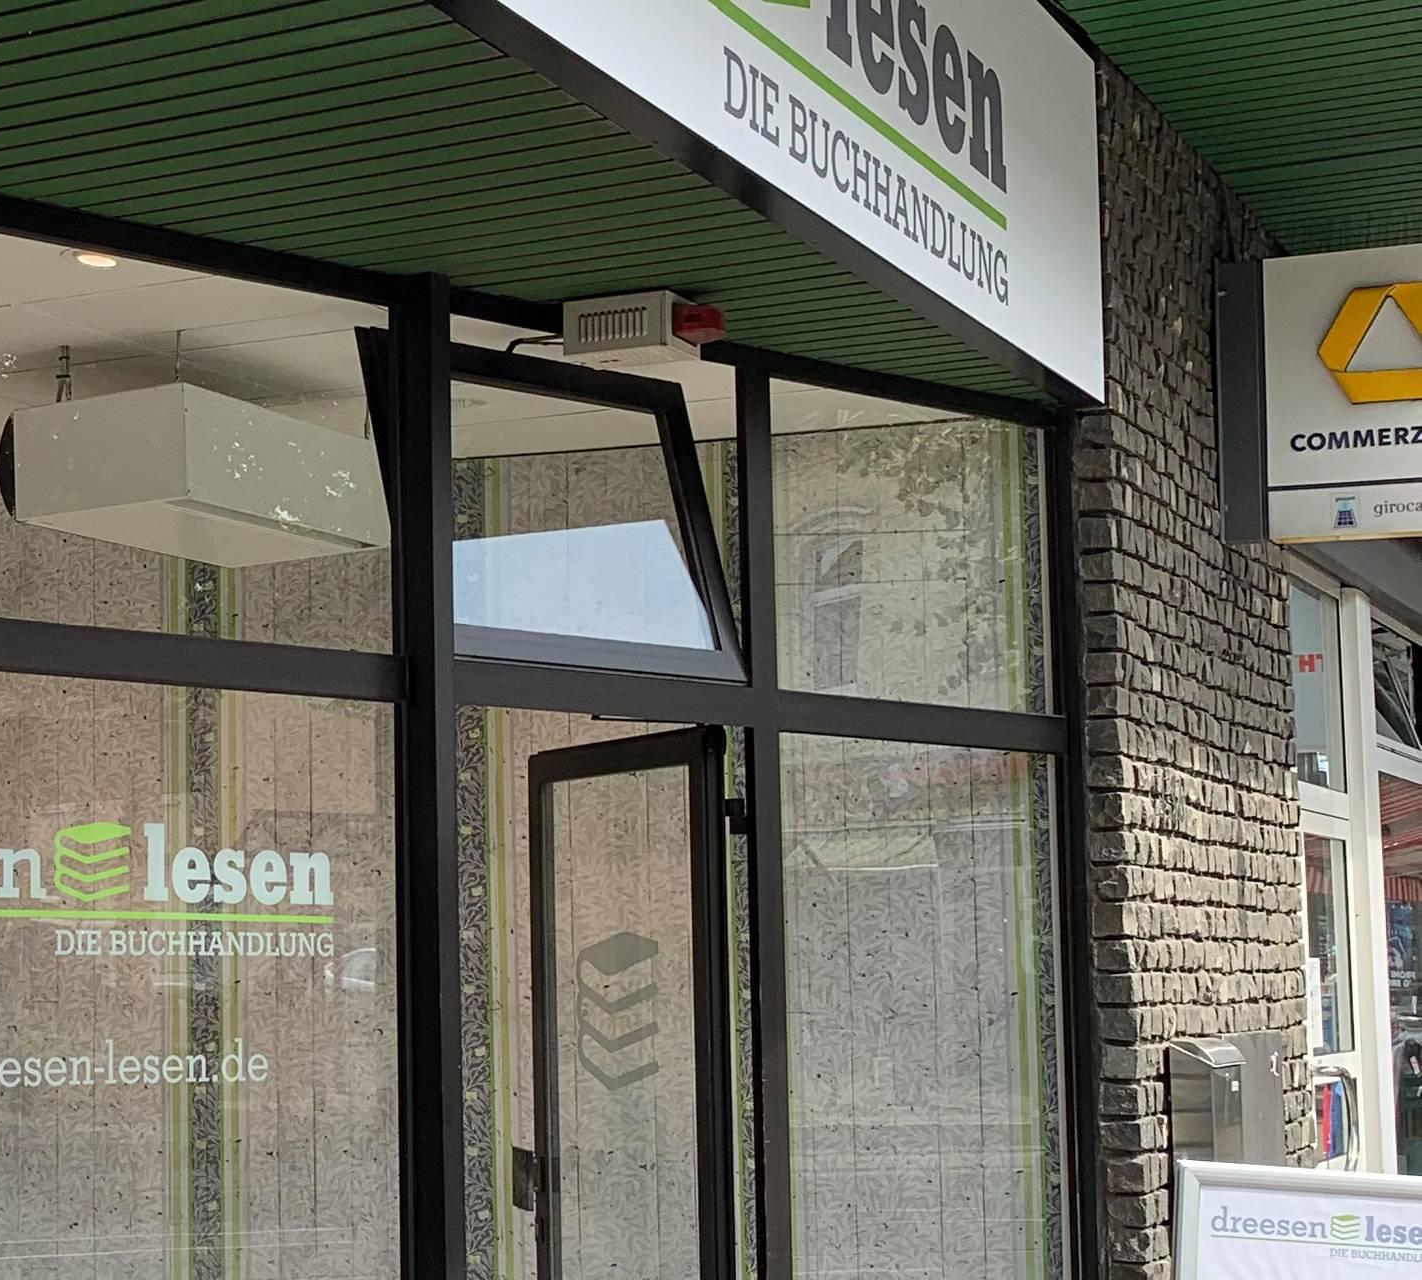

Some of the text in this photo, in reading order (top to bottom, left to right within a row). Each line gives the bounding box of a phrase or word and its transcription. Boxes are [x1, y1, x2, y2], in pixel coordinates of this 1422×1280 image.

[723, 45, 1009, 306] DIE BUCHHANDLUNG
[1289, 426, 1422, 452] COMMERZ
[144, 823, 335, 905] lesen
[55, 929, 336, 959] DIE BUCHHANDLUNG
[1211, 1206, 1328, 1239] dreesen
[1329, 1248, 1349, 1258] DIE
